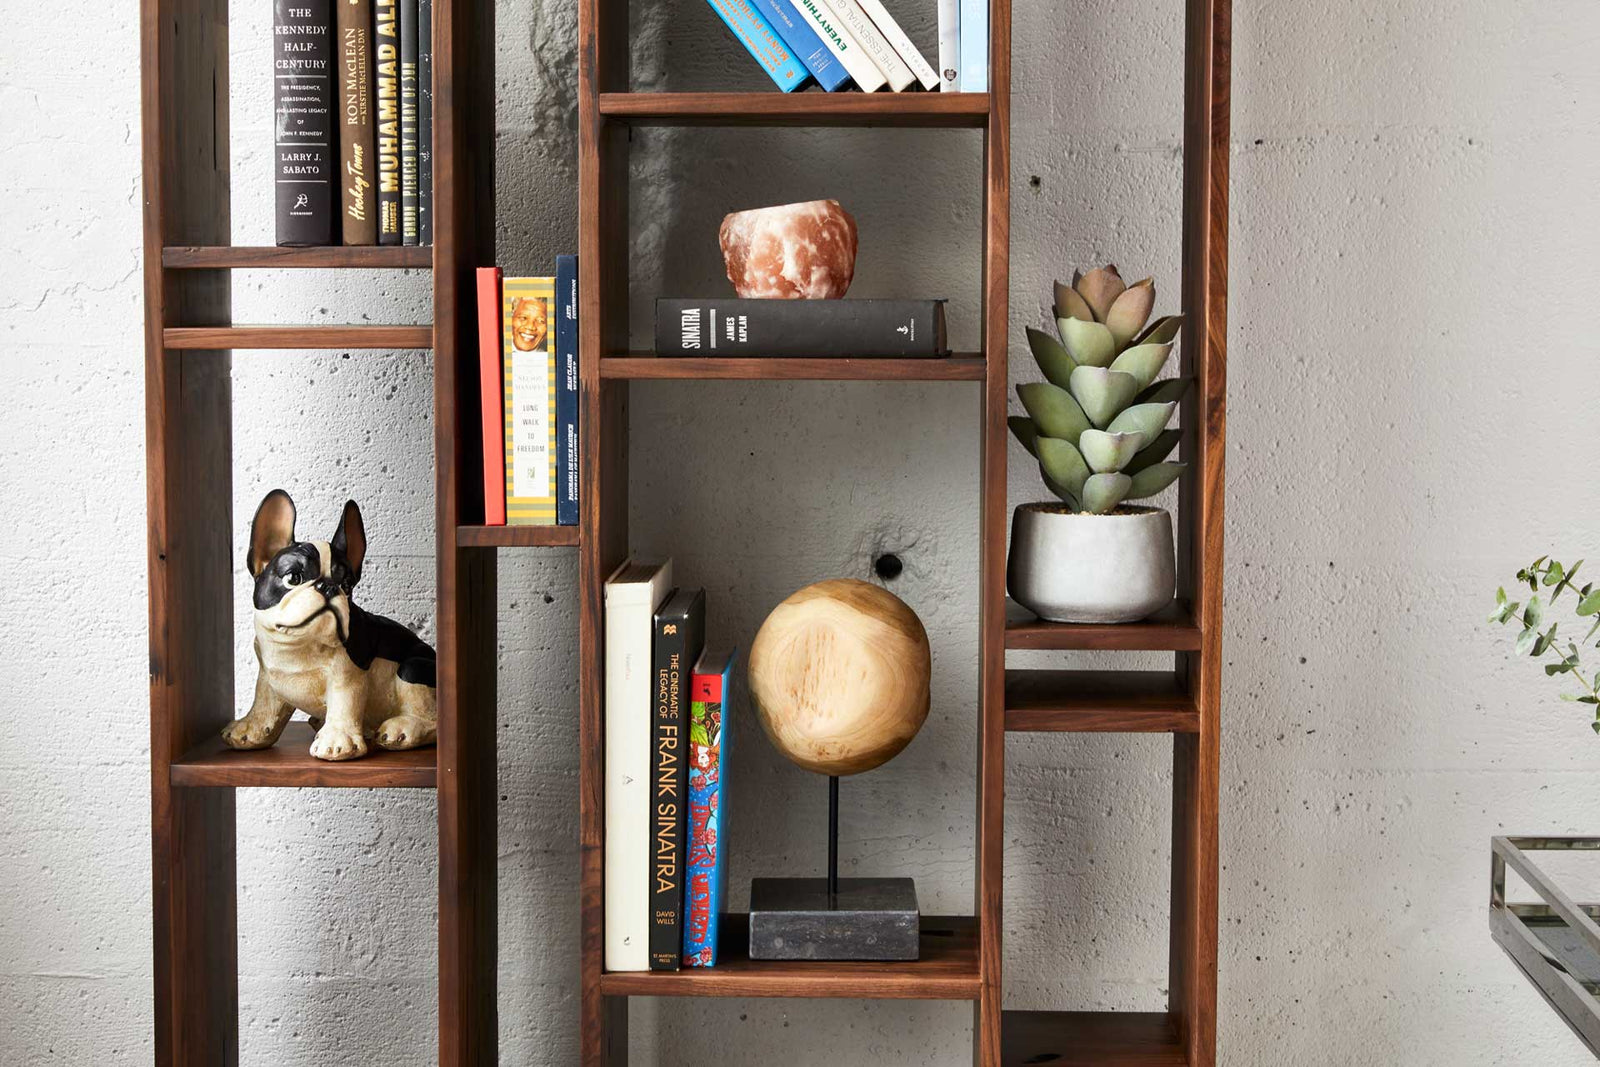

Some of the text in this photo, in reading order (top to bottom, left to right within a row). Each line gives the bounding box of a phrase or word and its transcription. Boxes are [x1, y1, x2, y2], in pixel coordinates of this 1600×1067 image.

[289, 8, 311, 18] THE
[733, 0, 764, 30] PYTHO
[275, 26, 327, 35] KENNEDY
[357, 27, 365, 44] DAY
[846, 8, 882, 55] ESSENTIAL
[284, 43, 317, 52] HALF-
[762, 30, 789, 62] MONTY
[275, 60, 327, 69] CENTURY
[879, 54, 897, 74] THE
[359, 84, 367, 115] KIRSTIE
[401, 86, 416, 98] OF
[346, 94, 359, 126] RON
[377, 43, 399, 193] MUHAMMAD
[401, 102, 416, 122] RAY
[281, 153, 322, 162] LARRY J.
[282, 166, 320, 175] SABATO
[346, 142, 370, 221] Hockey Towns
[381, 200, 389, 234] THOMAS
[389, 201, 397, 233] HAUSER
[681, 308, 701, 349] SINATRA
[726, 317, 736, 341] JAMES
[738, 315, 748, 342] KAPLAN
[522, 404, 539, 412] LONG
[522, 418, 540, 426] WALK
[527, 432, 535, 440] TO
[517, 445, 545, 453] FREEDOM
[659, 668, 669, 719] LEGACY OF
[670, 653, 679, 719] THE CINEMATIC
[656, 725, 679, 894] FRANK SINATRA
[656, 910, 675, 918] DAVID
